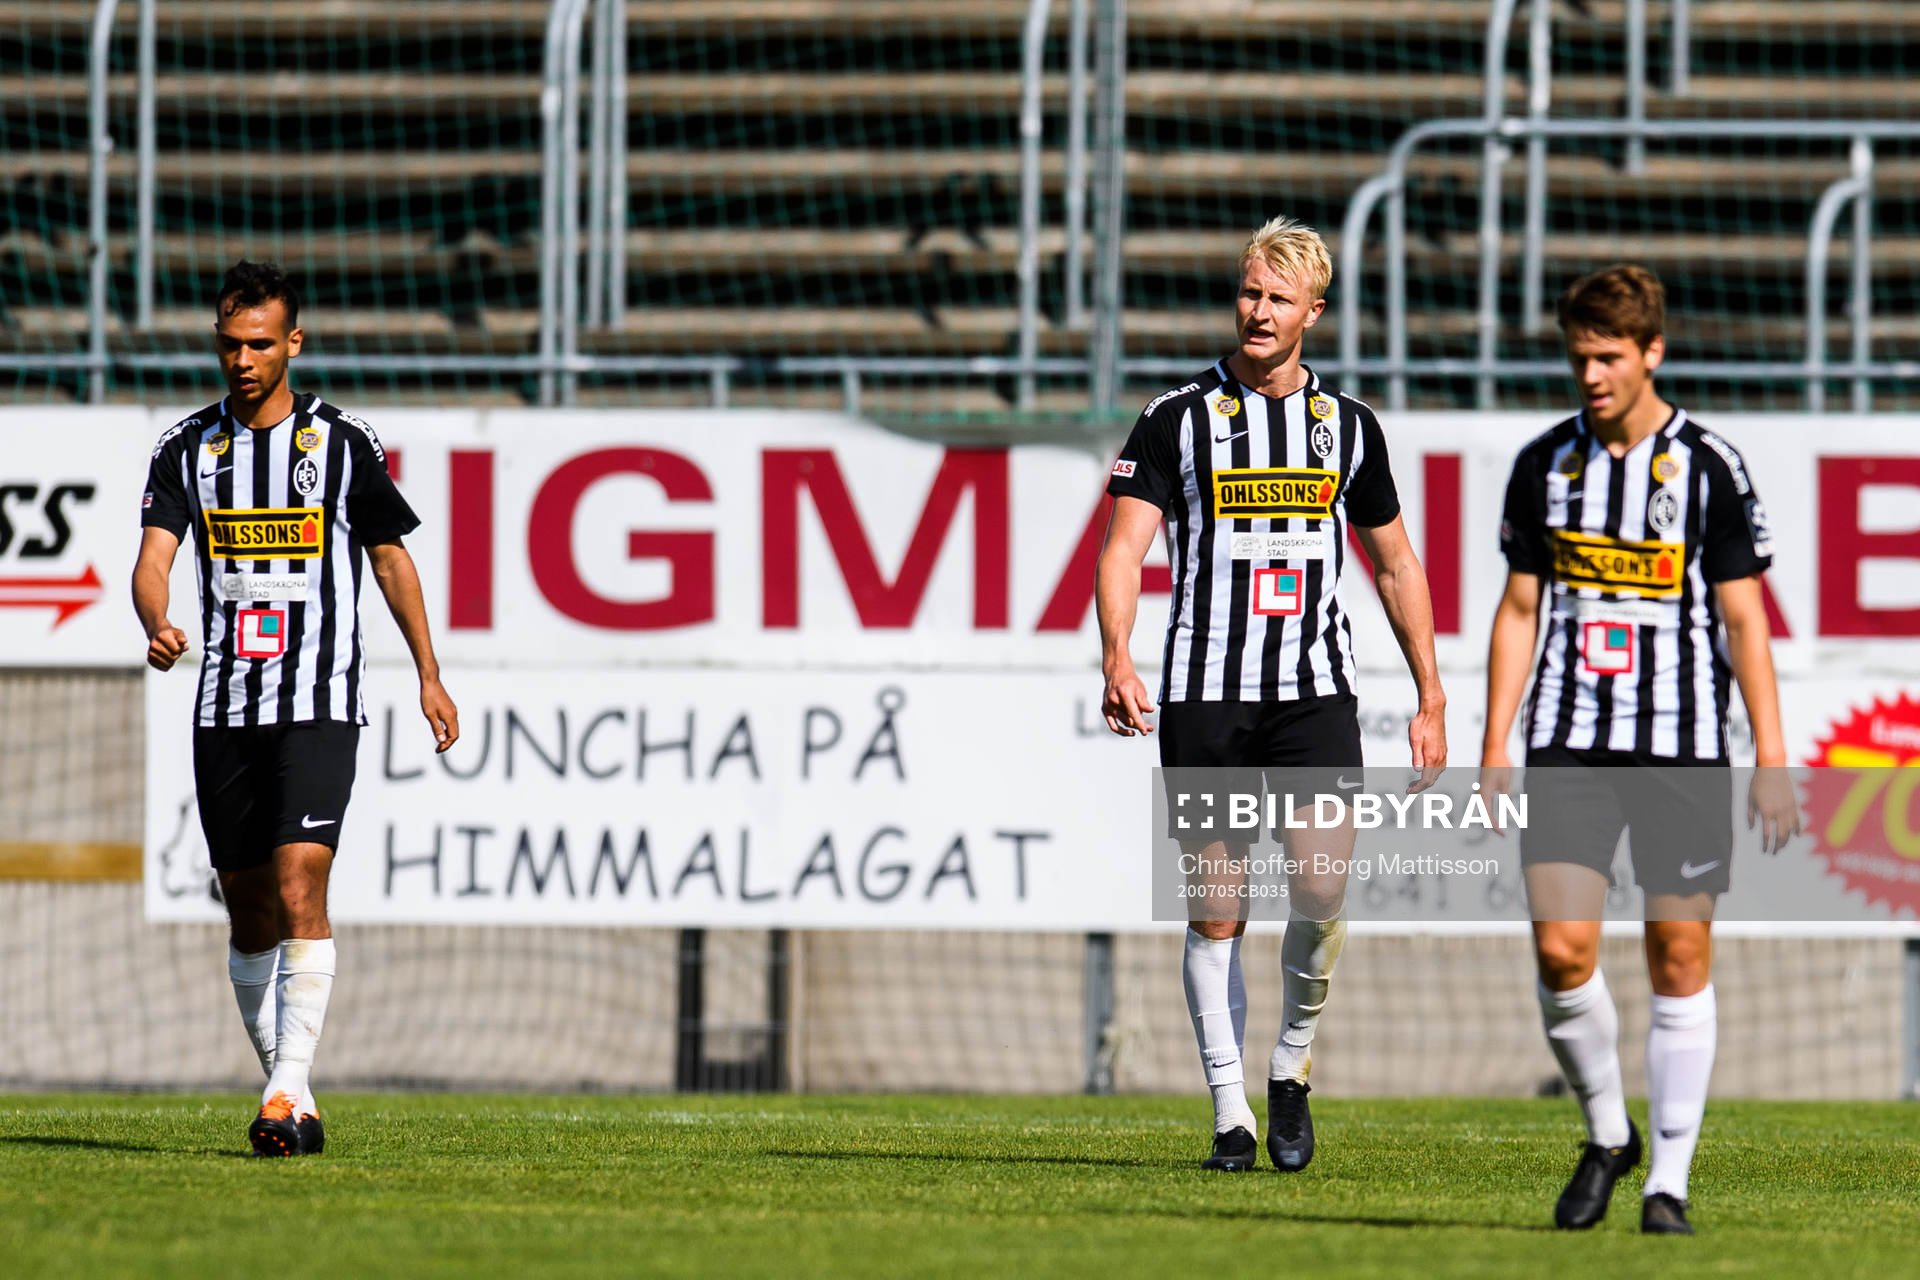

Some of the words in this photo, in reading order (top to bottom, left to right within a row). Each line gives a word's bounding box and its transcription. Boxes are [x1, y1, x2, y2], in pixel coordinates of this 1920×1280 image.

[1220, 483, 1318, 504] OHLSSONS
[213, 523, 300, 545] OHLSSONS
[1266, 539, 1324, 548] LANDSKRONA
[1266, 549, 1288, 558] STAD
[1560, 550, 1654, 578] SSONS
[249, 591, 270, 599] STAD
[382, 706, 762, 781] LUNCHA
[801, 686, 908, 781] PÅ
[384, 823, 1052, 903] HIMMALAGAT
